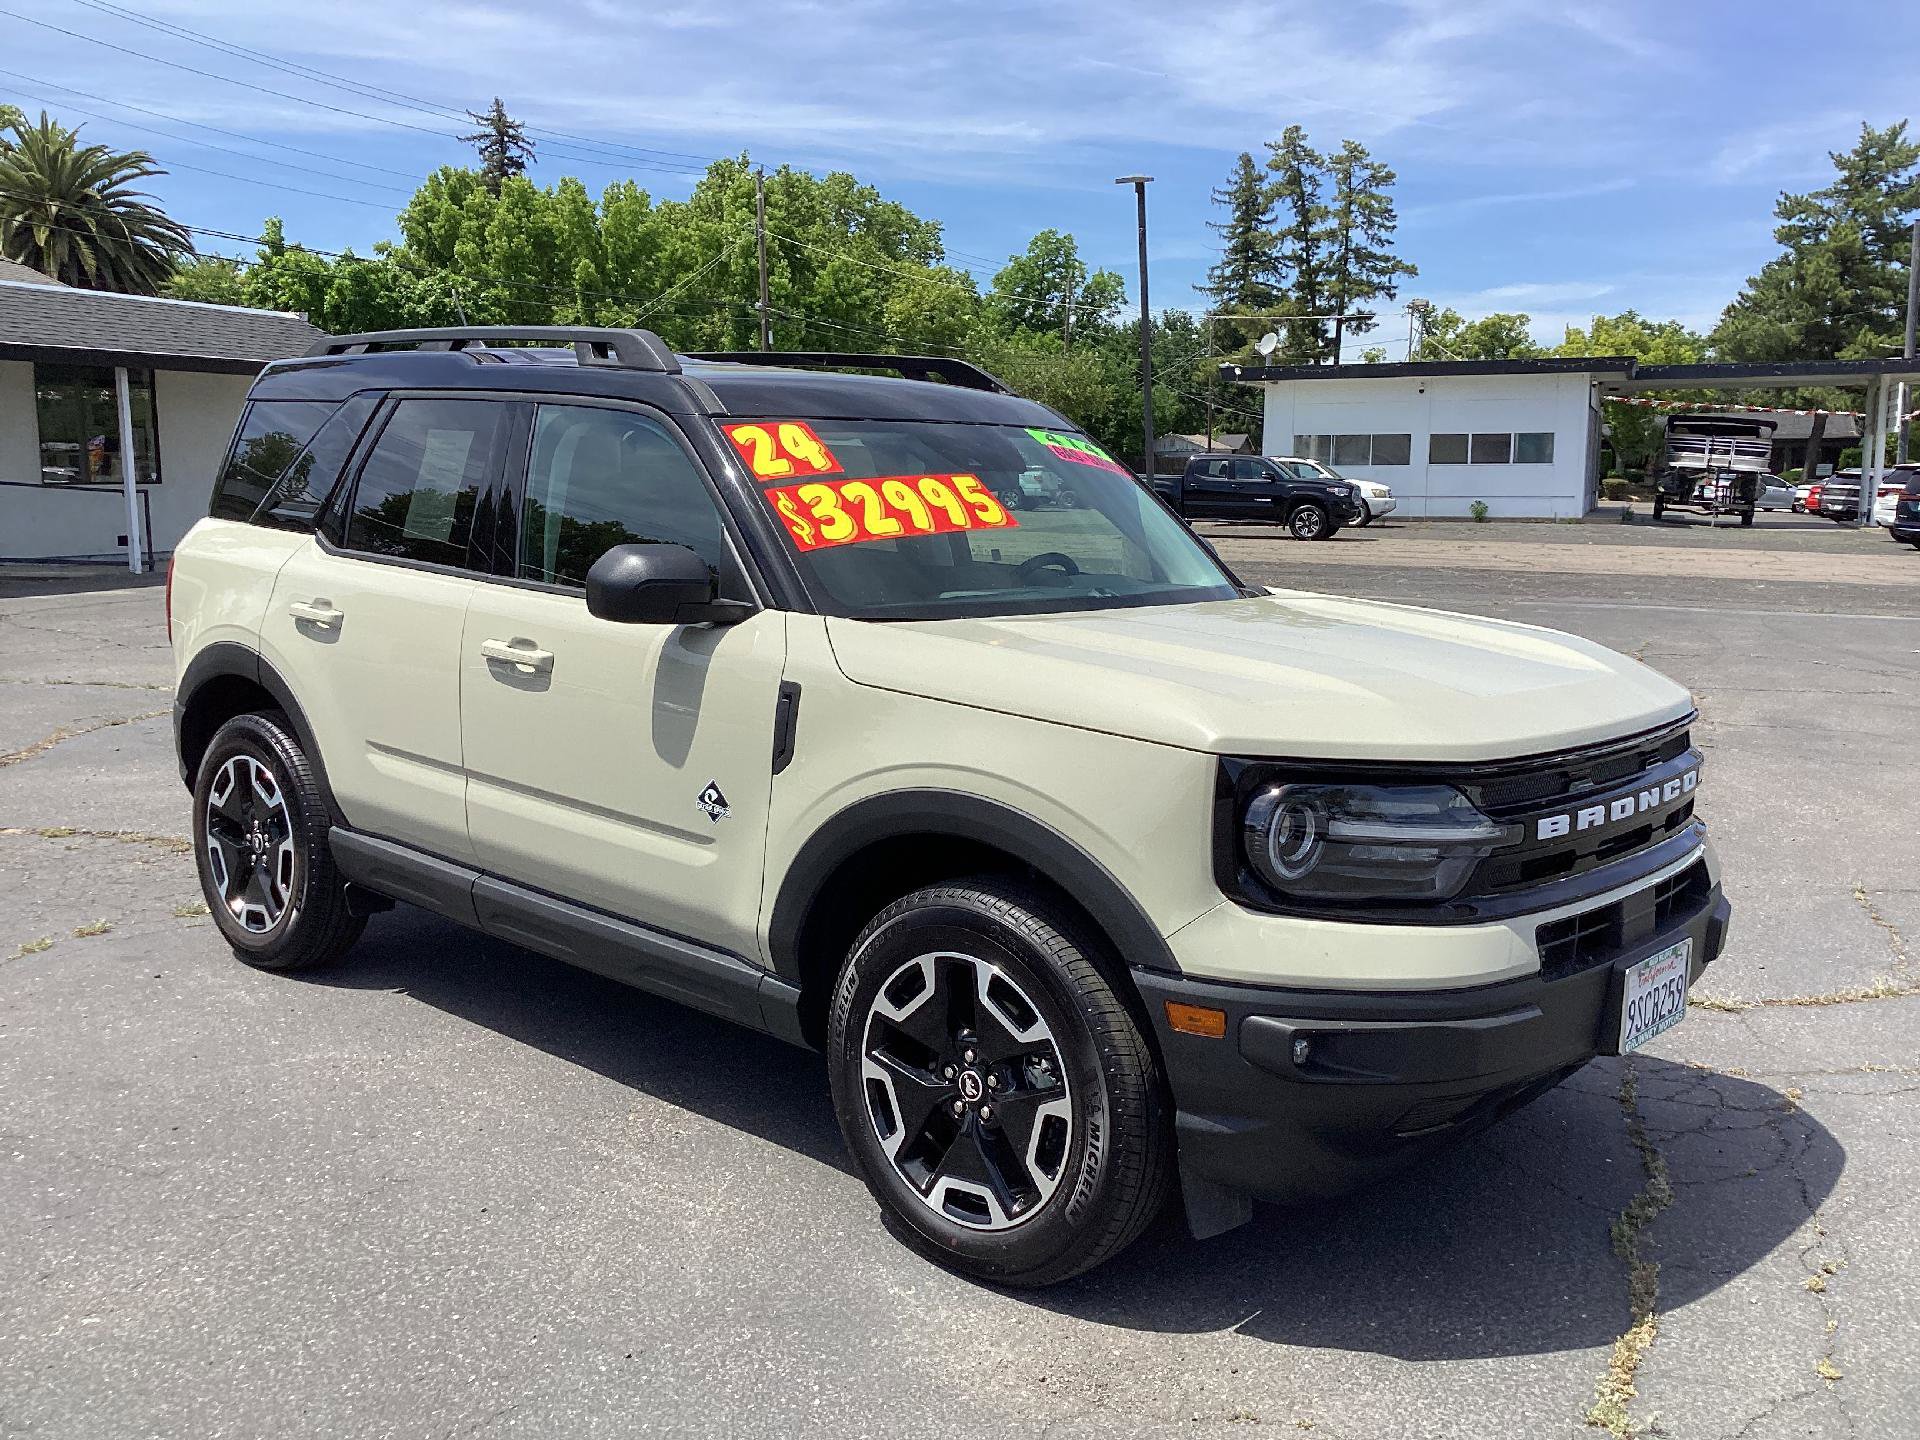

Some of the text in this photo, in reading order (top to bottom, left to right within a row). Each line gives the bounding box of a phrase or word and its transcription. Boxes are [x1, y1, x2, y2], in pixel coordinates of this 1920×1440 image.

[731, 423, 832, 477] 24
[776, 476, 1008, 546] $32995
[1537, 770, 1697, 841] BRONCO
[1626, 974, 1684, 1040] 9SCB259
[1070, 1119, 1101, 1217] MICHELIN
